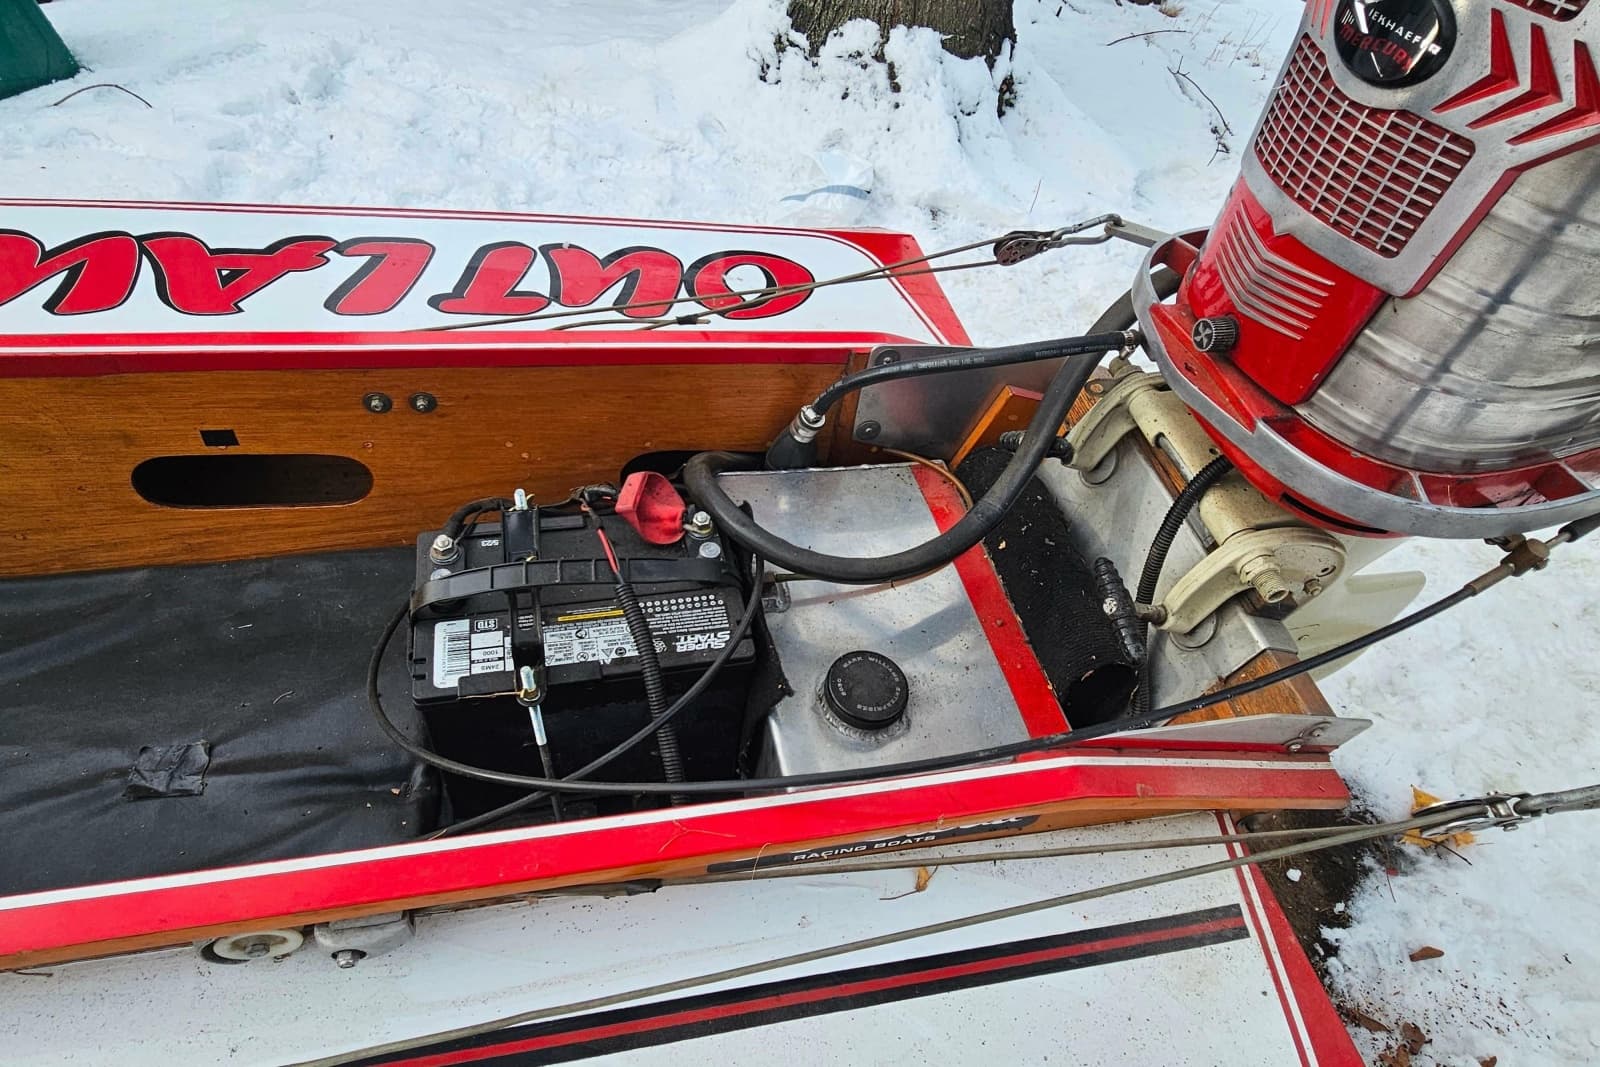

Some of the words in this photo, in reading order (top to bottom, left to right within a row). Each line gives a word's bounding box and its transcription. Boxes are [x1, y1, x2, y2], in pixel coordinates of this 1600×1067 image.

[676, 630, 731, 644] START
[676, 641, 726, 653] SUPER
[793, 845, 867, 861] RACING
[874, 834, 936, 849] BOATS
